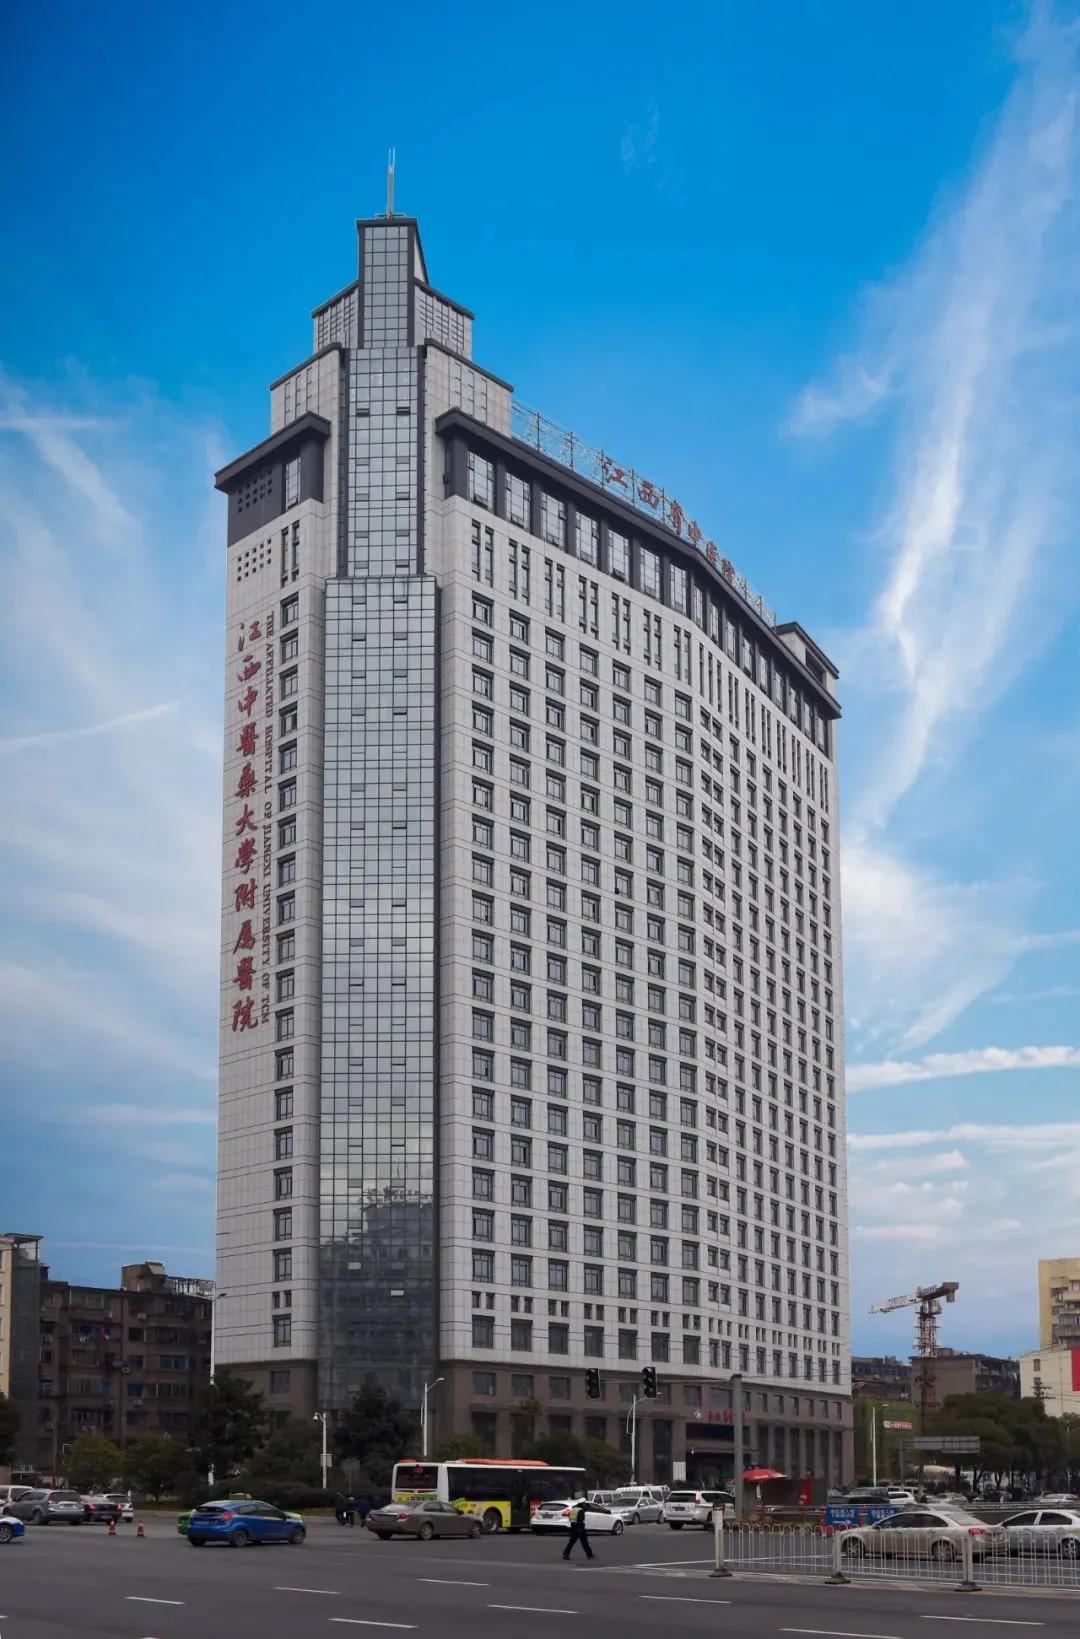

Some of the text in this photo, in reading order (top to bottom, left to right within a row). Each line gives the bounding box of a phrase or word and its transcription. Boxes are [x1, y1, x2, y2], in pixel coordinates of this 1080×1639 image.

[261, 610, 275, 1024] THE AFFILIATED HOSPITAL OF JIANGXI UNIVERSITY OF TCM
